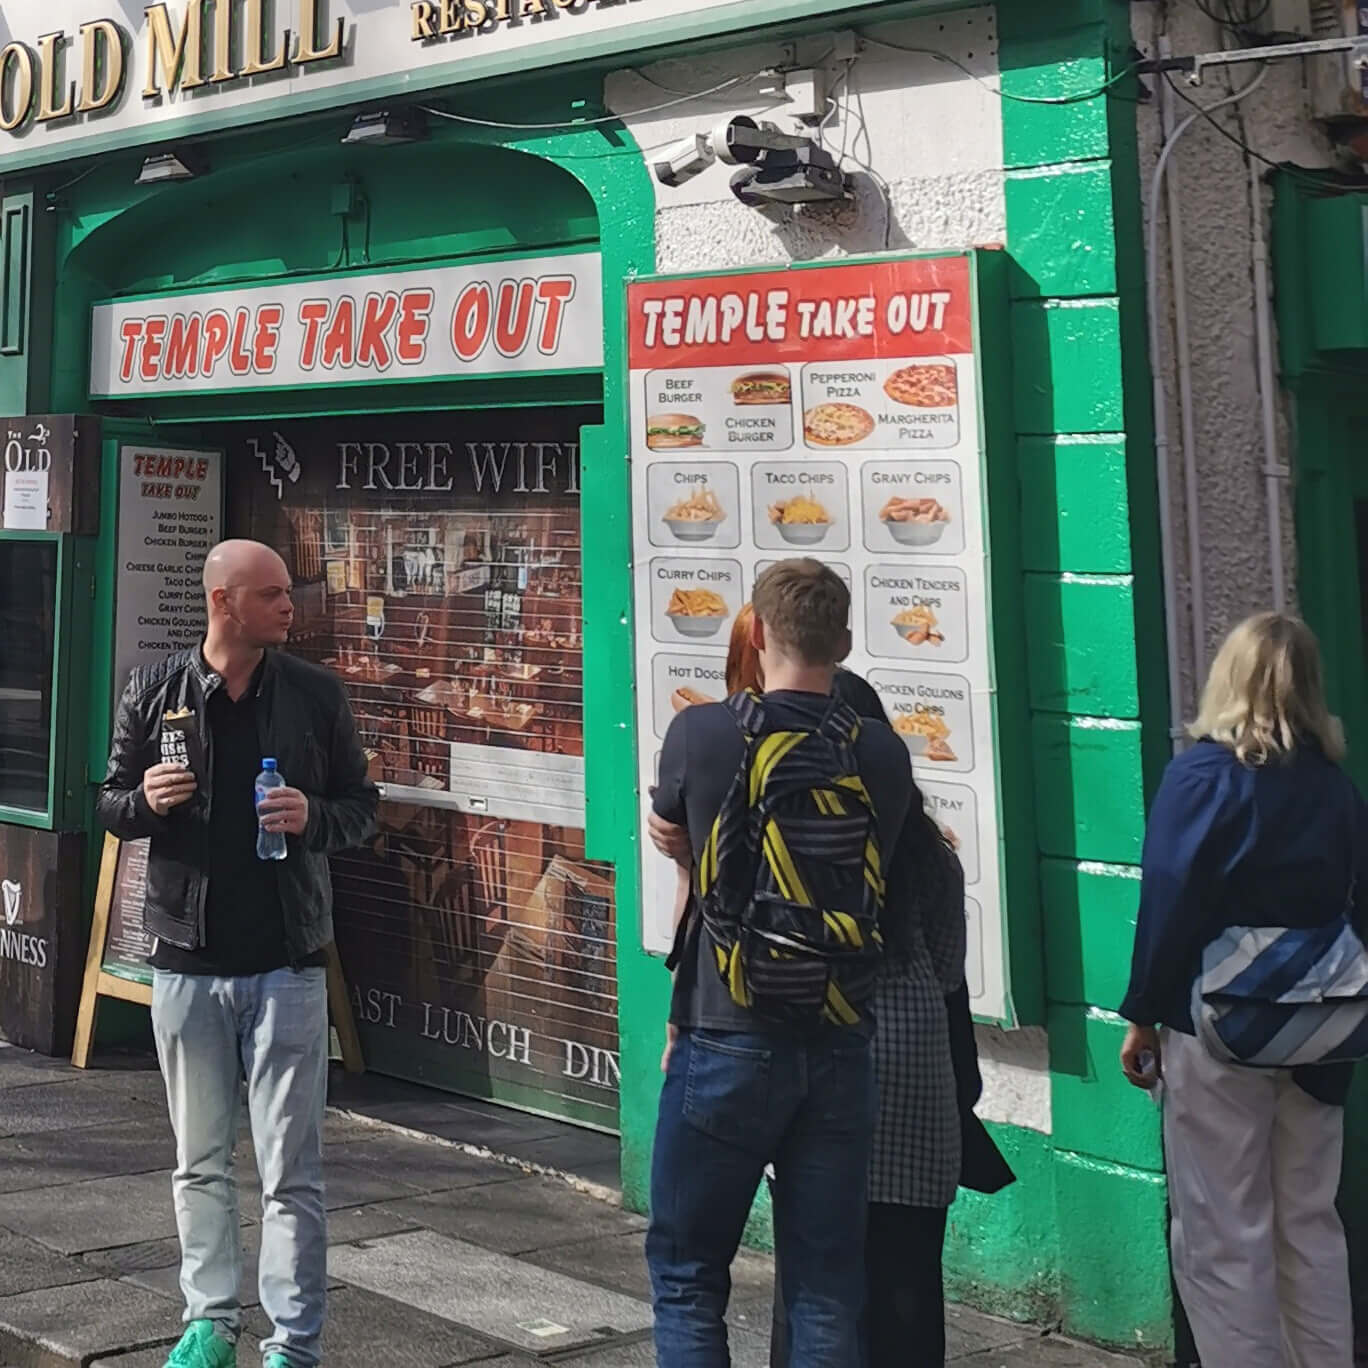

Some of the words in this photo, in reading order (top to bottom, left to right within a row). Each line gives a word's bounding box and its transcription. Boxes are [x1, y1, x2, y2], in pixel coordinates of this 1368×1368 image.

[642, 289, 790, 349] TEMPLE
[797, 296, 877, 339] TAKE
[886, 291, 951, 334] OUT
[120, 304, 284, 383] TEMPLE
[298, 287, 435, 372] TAKE
[450, 274, 577, 363] OUT
[665, 378, 694, 391] BEEF
[810, 372, 876, 385] PEPPERONI
[658, 391, 702, 404] BURGER
[826, 385, 862, 399] PIZZA
[725, 417, 776, 430] CHICKEN
[878, 413, 955, 425] MARGHERITA
[728, 431, 774, 443] BURGER
[898, 427, 935, 440] PIZZA
[4, 440, 51, 472] OLD
[133, 452, 209, 482] TEMPLE
[335, 442, 454, 492] FREE
[466, 442, 581, 494] WIFI
[673, 472, 708, 485] CHIPS
[765, 472, 796, 485] TACO
[801, 472, 835, 485] CHIPS
[871, 472, 911, 485] GRAVY
[916, 472, 951, 485] CHIPS
[140, 482, 172, 500] TAKE
[174, 484, 202, 501] OUT
[144, 536, 177, 546] CHICKEN
[126, 562, 156, 572] CHEESE
[657, 568, 695, 581] CURRY
[697, 569, 732, 583] CHIPS
[870, 576, 913, 591] CHICKEN
[915, 578, 961, 592] TENDERS
[888, 595, 909, 607] AND
[912, 595, 941, 609] CHIPS
[138, 616, 171, 627] CHICKEN
[138, 640, 171, 650] CHICKEN
[668, 665, 692, 679] HOT
[873, 681, 916, 696] CHICKEN
[917, 685, 965, 700] GOUJONS
[892, 702, 913, 713] AND
[932, 795, 964, 811] TRAY
[420, 1002, 534, 1065] LUNCH
